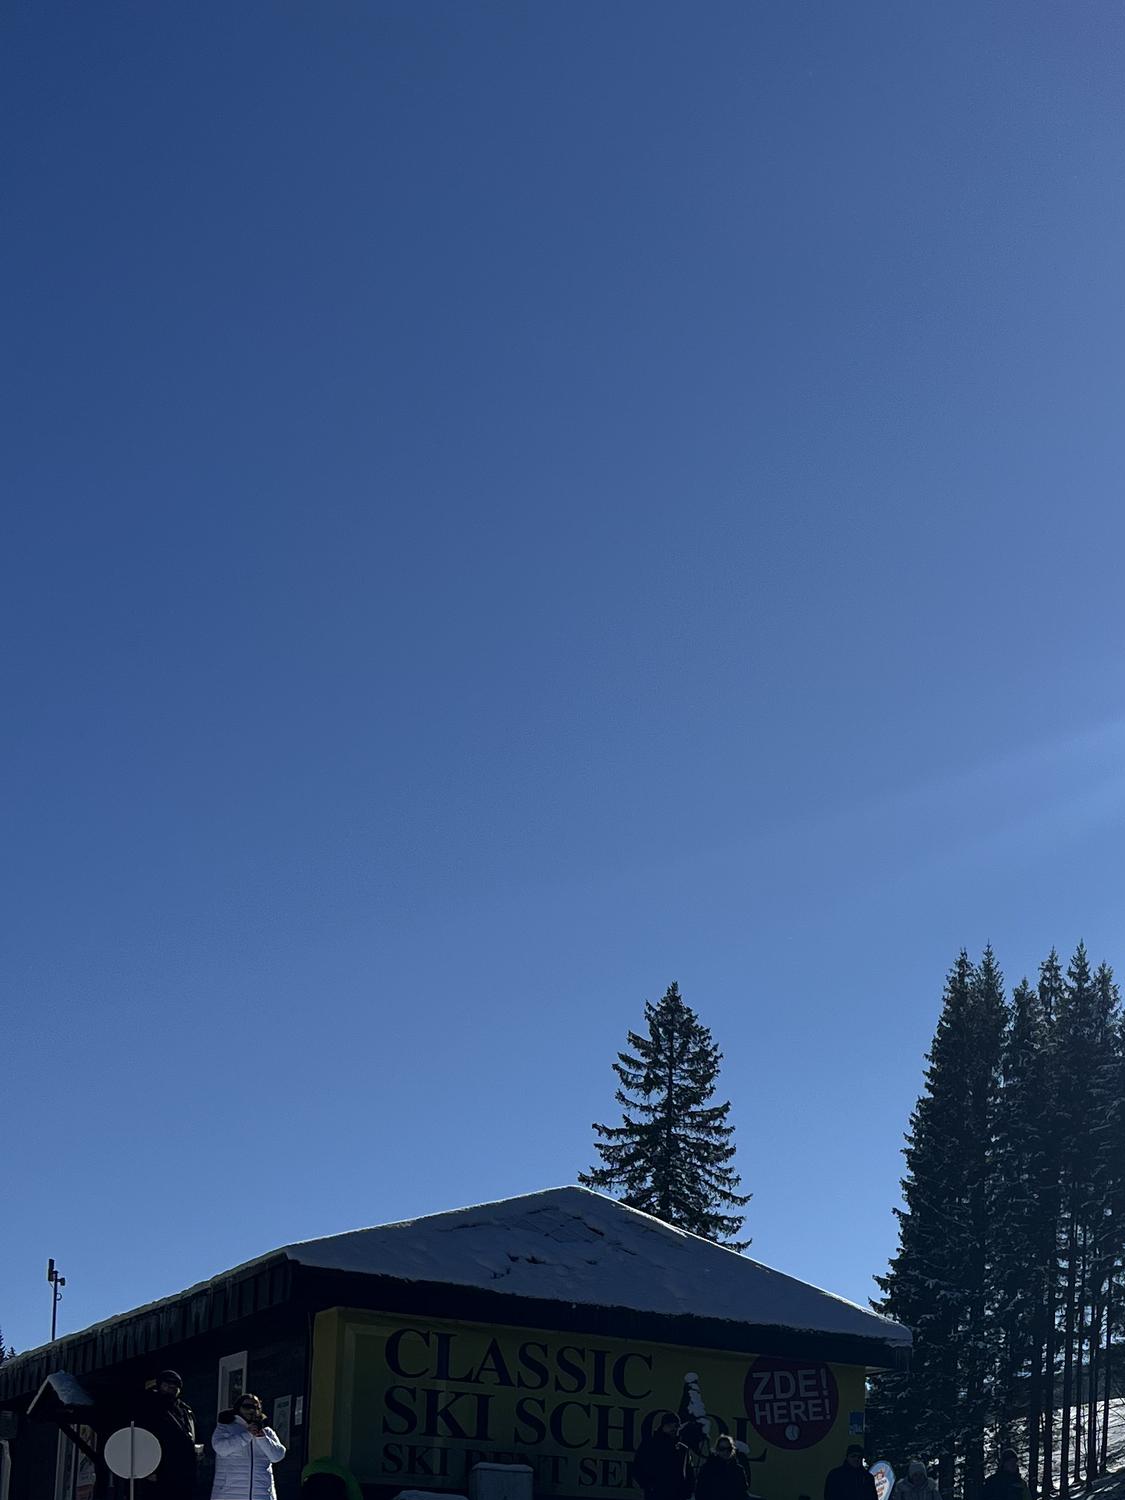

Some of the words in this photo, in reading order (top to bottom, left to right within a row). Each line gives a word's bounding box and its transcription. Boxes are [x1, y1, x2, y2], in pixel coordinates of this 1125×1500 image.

[385, 1328, 652, 1399] CLASSIC
[751, 1367, 829, 1400] ZDE!
[382, 1385, 495, 1441] SKI
[754, 1399, 831, 1425] HERE!
[381, 1443, 449, 1476] SKI
